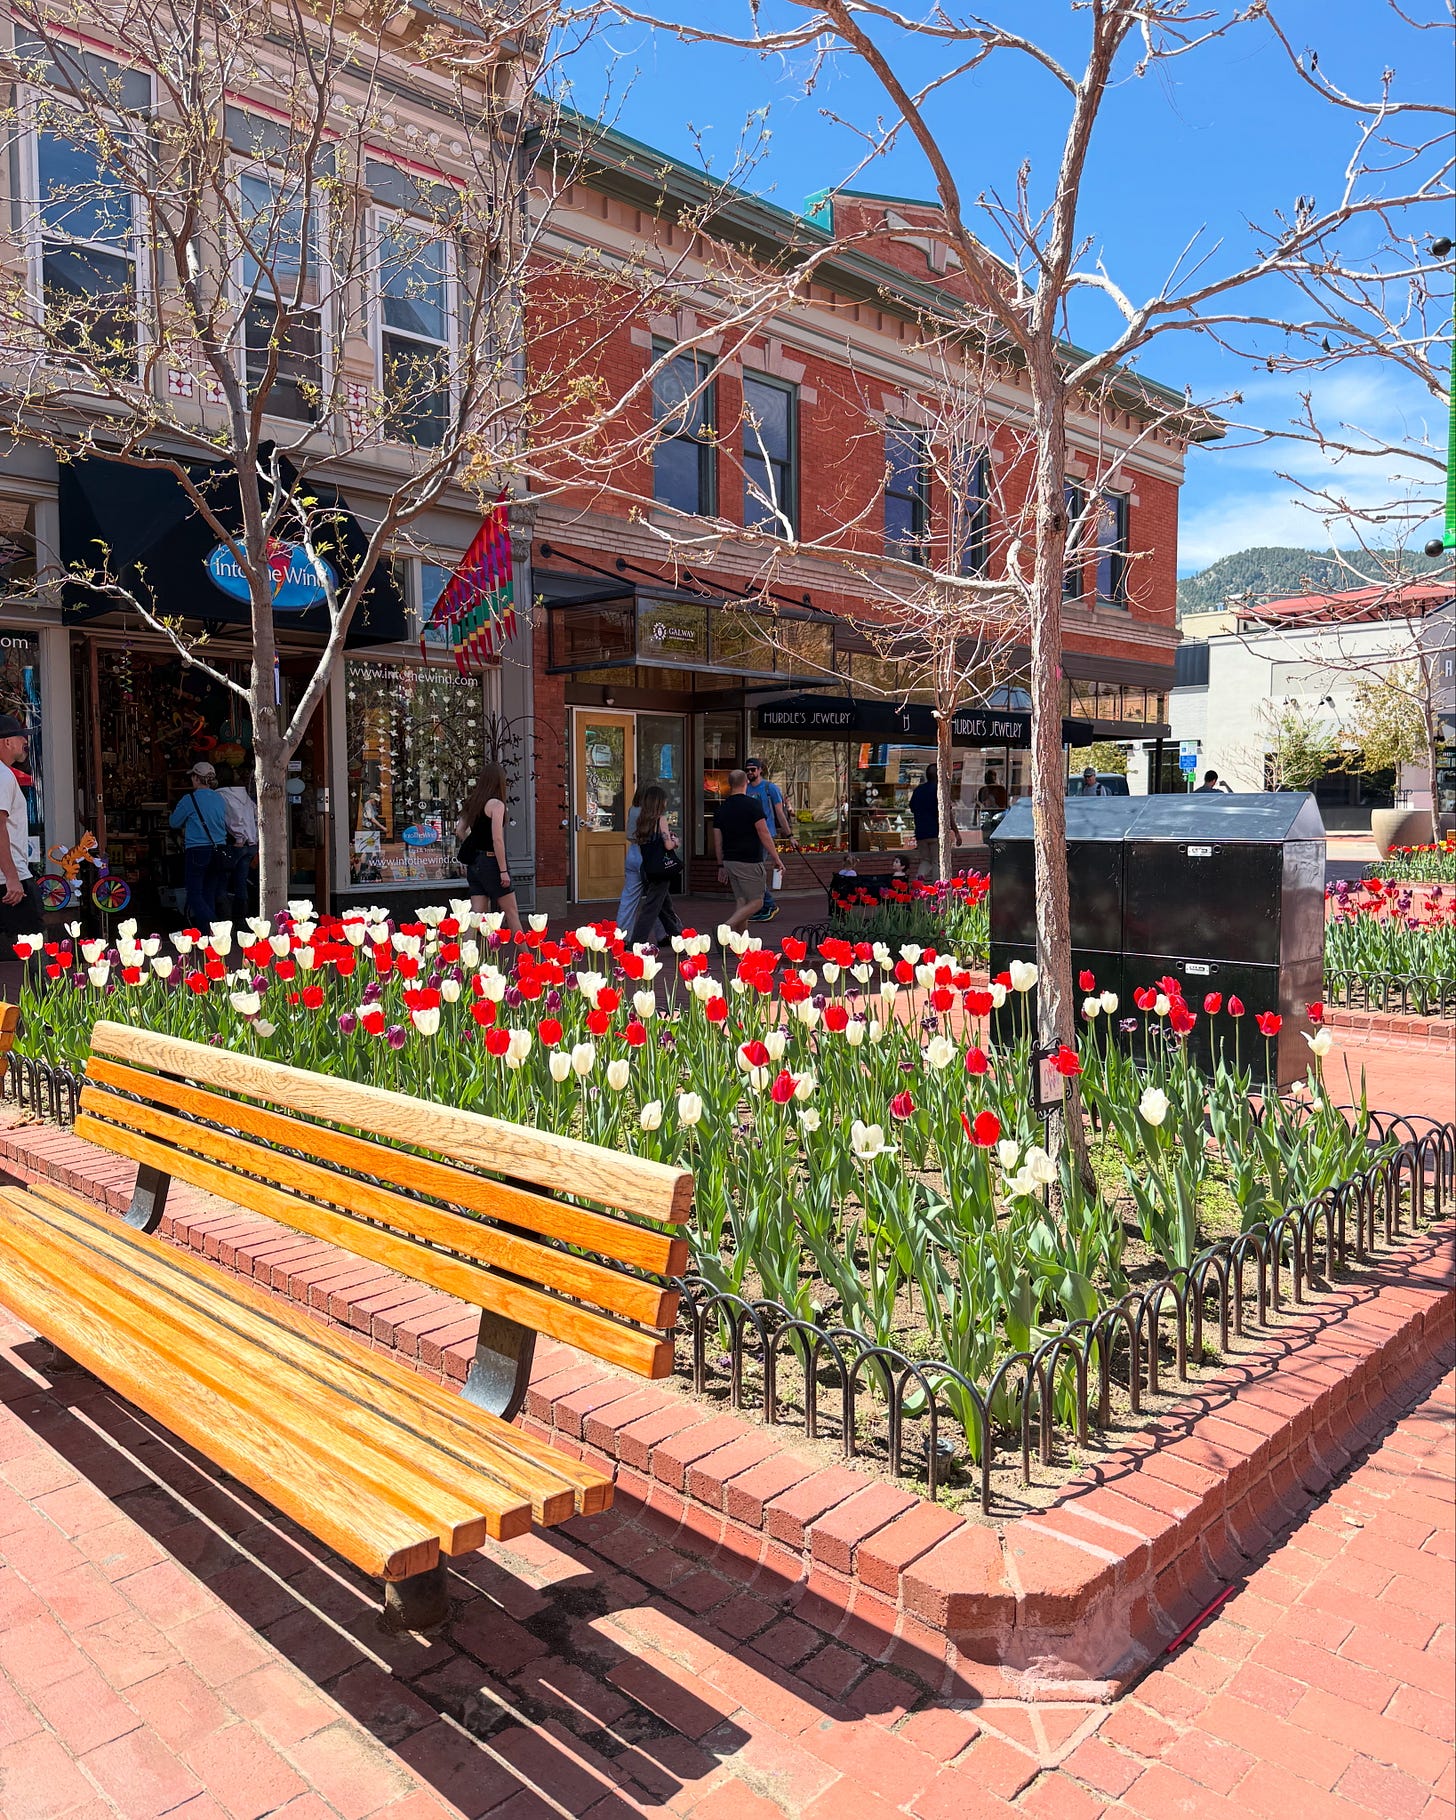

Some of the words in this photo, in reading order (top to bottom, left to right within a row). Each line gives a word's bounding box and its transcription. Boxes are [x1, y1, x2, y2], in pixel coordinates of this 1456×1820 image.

[668, 627, 695, 638] GALWAY
[763, 712, 806, 725] HURDLE'S
[810, 712, 851, 725] JEWELRY
[990, 720, 1022, 738] JEWELRY
